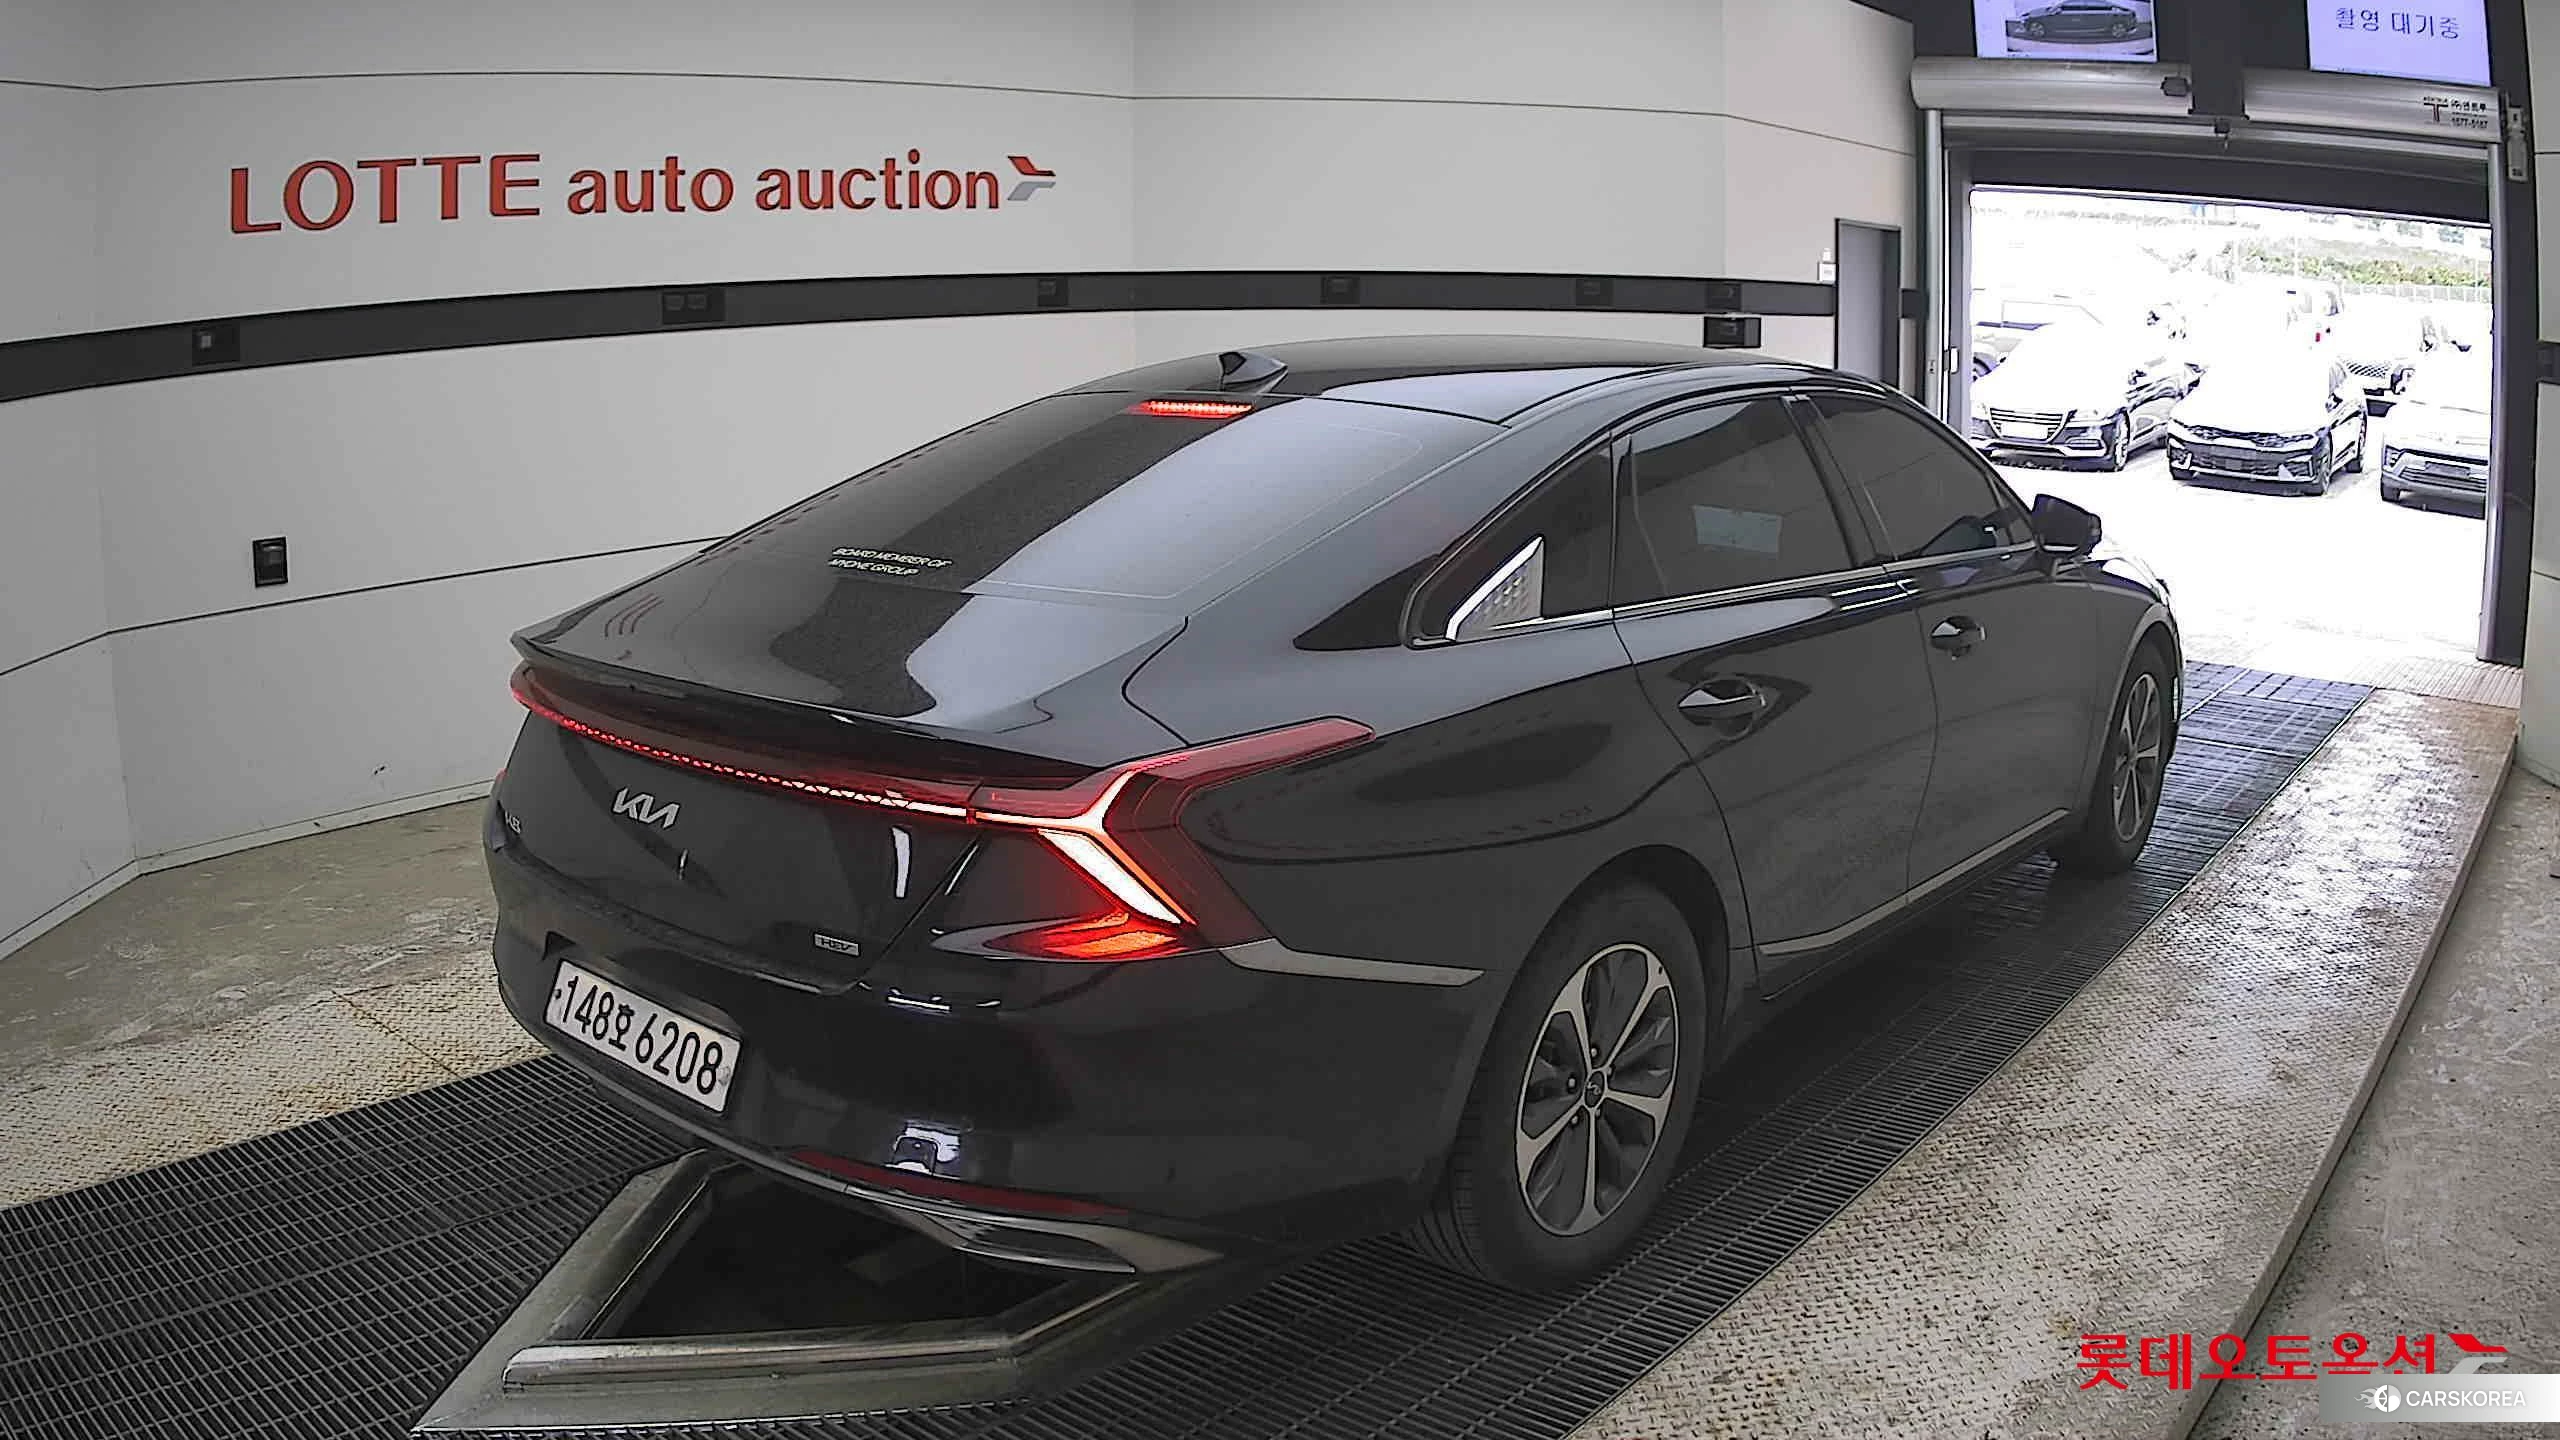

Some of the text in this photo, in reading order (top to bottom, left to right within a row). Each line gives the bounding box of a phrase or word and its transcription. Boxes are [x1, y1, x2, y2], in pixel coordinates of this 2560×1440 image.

[2335, 6, 2460, 40] 촬영 대기중
[230, 147, 1001, 234] LOTTE auto auction
[611, 786, 681, 829] KIA
